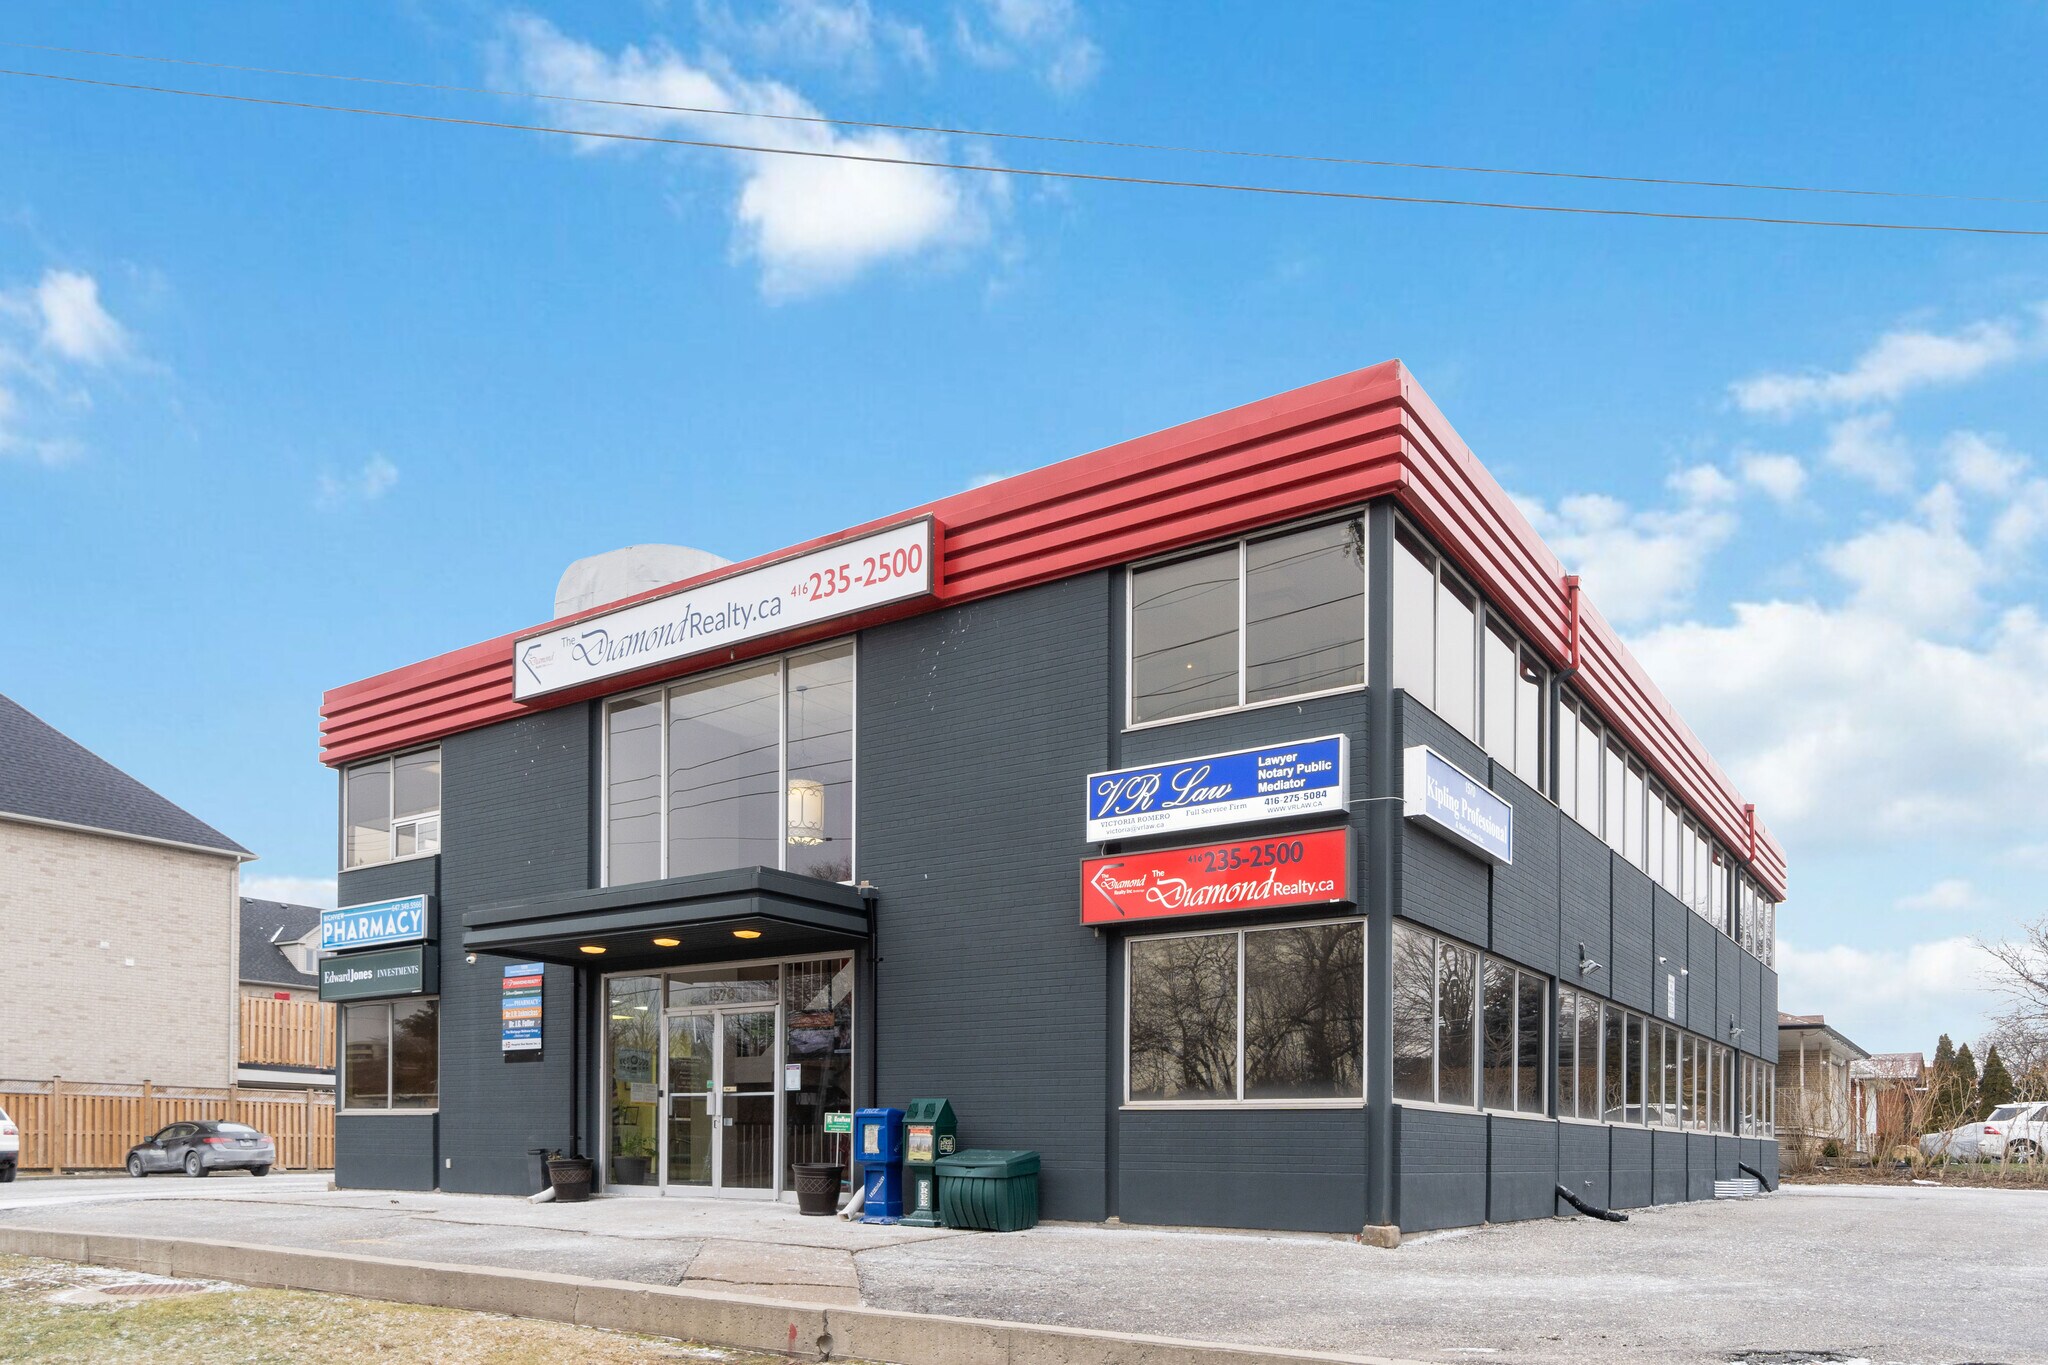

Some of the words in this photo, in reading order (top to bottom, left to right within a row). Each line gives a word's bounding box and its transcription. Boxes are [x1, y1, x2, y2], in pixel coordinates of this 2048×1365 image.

[791, 582, 809, 597] 416
[809, 543, 923, 602] 235-2500
[561, 637, 576, 647] The
[690, 596, 782, 638] Realty.ca
[1258, 753, 1298, 767] Lawyer
[1258, 767, 1294, 780] Notary
[1296, 760, 1332, 775] Public
[1097, 773, 1161, 817] VR
[1162, 765, 1232, 807] Law
[1258, 778, 1306, 793] Mediator
[1186, 808, 1200, 817] Full
[1201, 805, 1228, 815] Service
[1228, 802, 1248, 811] Firm
[1264, 790, 1328, 806] 416-275-5084
[1427, 775, 1460, 820] Kipling
[1461, 797, 1507, 844] Professional
[1101, 818, 1136, 828] VICTORIA
[1137, 813, 1171, 824] ROMERO
[1187, 853, 1203, 864] 416
[1204, 840, 1304, 873] 235-2500
[1101, 874, 1147, 890] Diamond
[1152, 869, 1165, 878] The
[1273, 879, 1335, 896] Realty.ca
[323, 909, 422, 943] PHARMACY
[377, 965, 419, 978] INVESTMENTS
[920, 1181, 928, 1207] FREE
